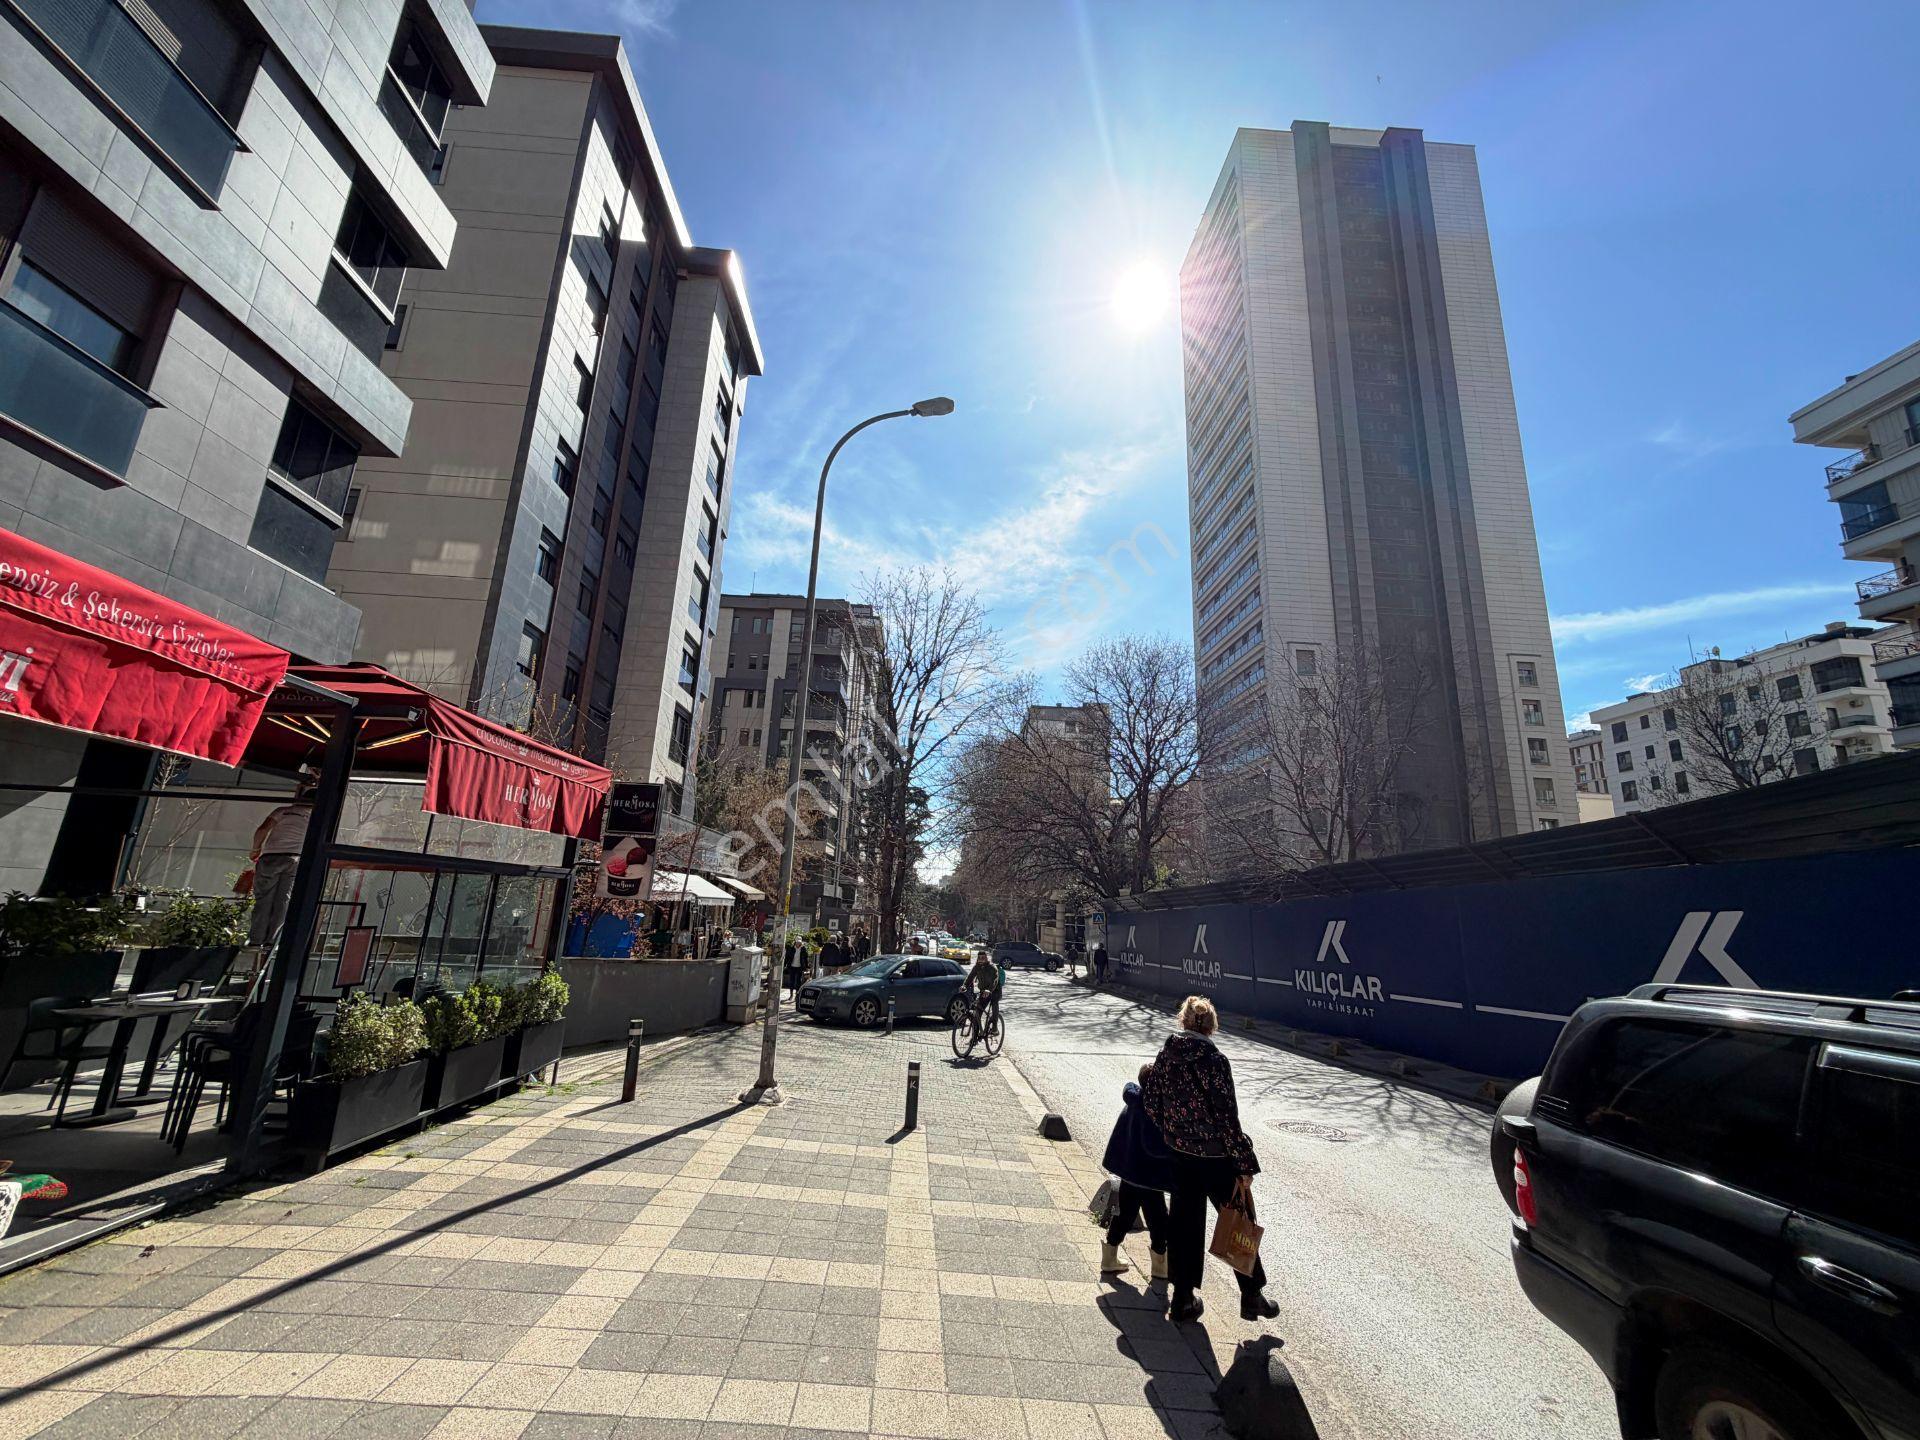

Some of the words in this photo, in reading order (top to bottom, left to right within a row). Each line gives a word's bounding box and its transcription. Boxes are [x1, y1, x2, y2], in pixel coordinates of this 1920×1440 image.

[61, 582, 79, 608] &
[83, 591, 165, 642] Şekersiz
[504, 784, 553, 812] HERMOS
[613, 799, 656, 810] HERMOSA
[1120, 952, 1145, 968] KILIÇLAR
[1182, 958, 1222, 980] KILIÇLAR
[1294, 969, 1386, 1003] KILIÇLAR
